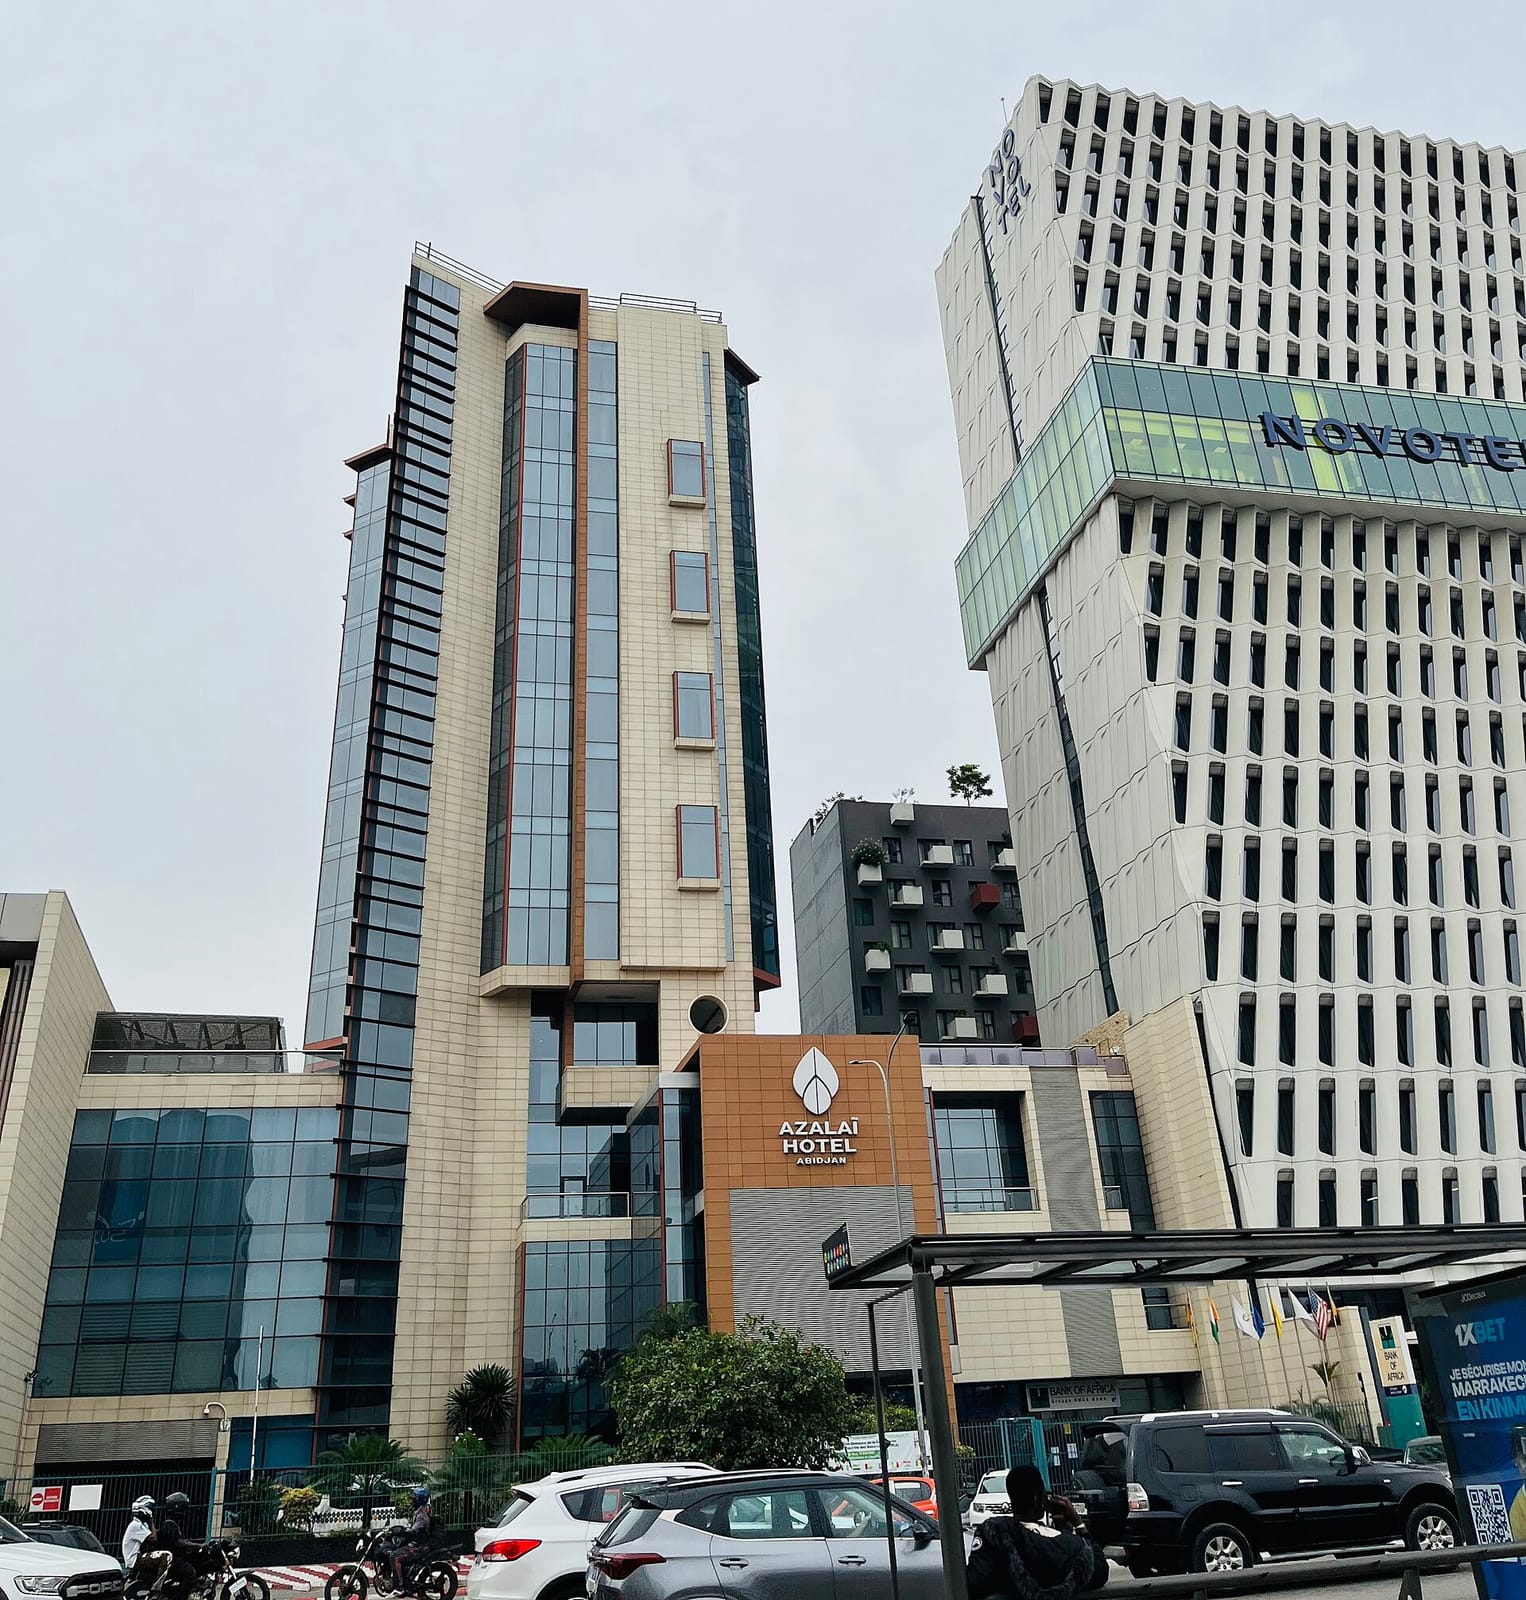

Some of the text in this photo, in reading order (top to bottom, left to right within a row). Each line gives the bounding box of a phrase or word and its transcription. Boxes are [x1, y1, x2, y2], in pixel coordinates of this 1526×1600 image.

[1258, 411, 1526, 472] NOVOTE
[778, 1117, 859, 1136] AZALAÏ
[783, 1138, 857, 1154] HOTEL
[796, 1156, 847, 1165] ABIDJAN
[1454, 1317, 1505, 1347] 1XBET
[1383, 1351, 1398, 1361] BANK
[1390, 1362, 1397, 1370] OF
[1449, 1368, 1462, 1381] JE
[1461, 1361, 1507, 1380] SÉCURISE
[1387, 1371, 1405, 1381] AFRICA
[1049, 1383, 1116, 1396] BANK OF AFRICA
[1451, 1374, 1526, 1398] MARRAKEC
[1456, 1399, 1480, 1421] EN
